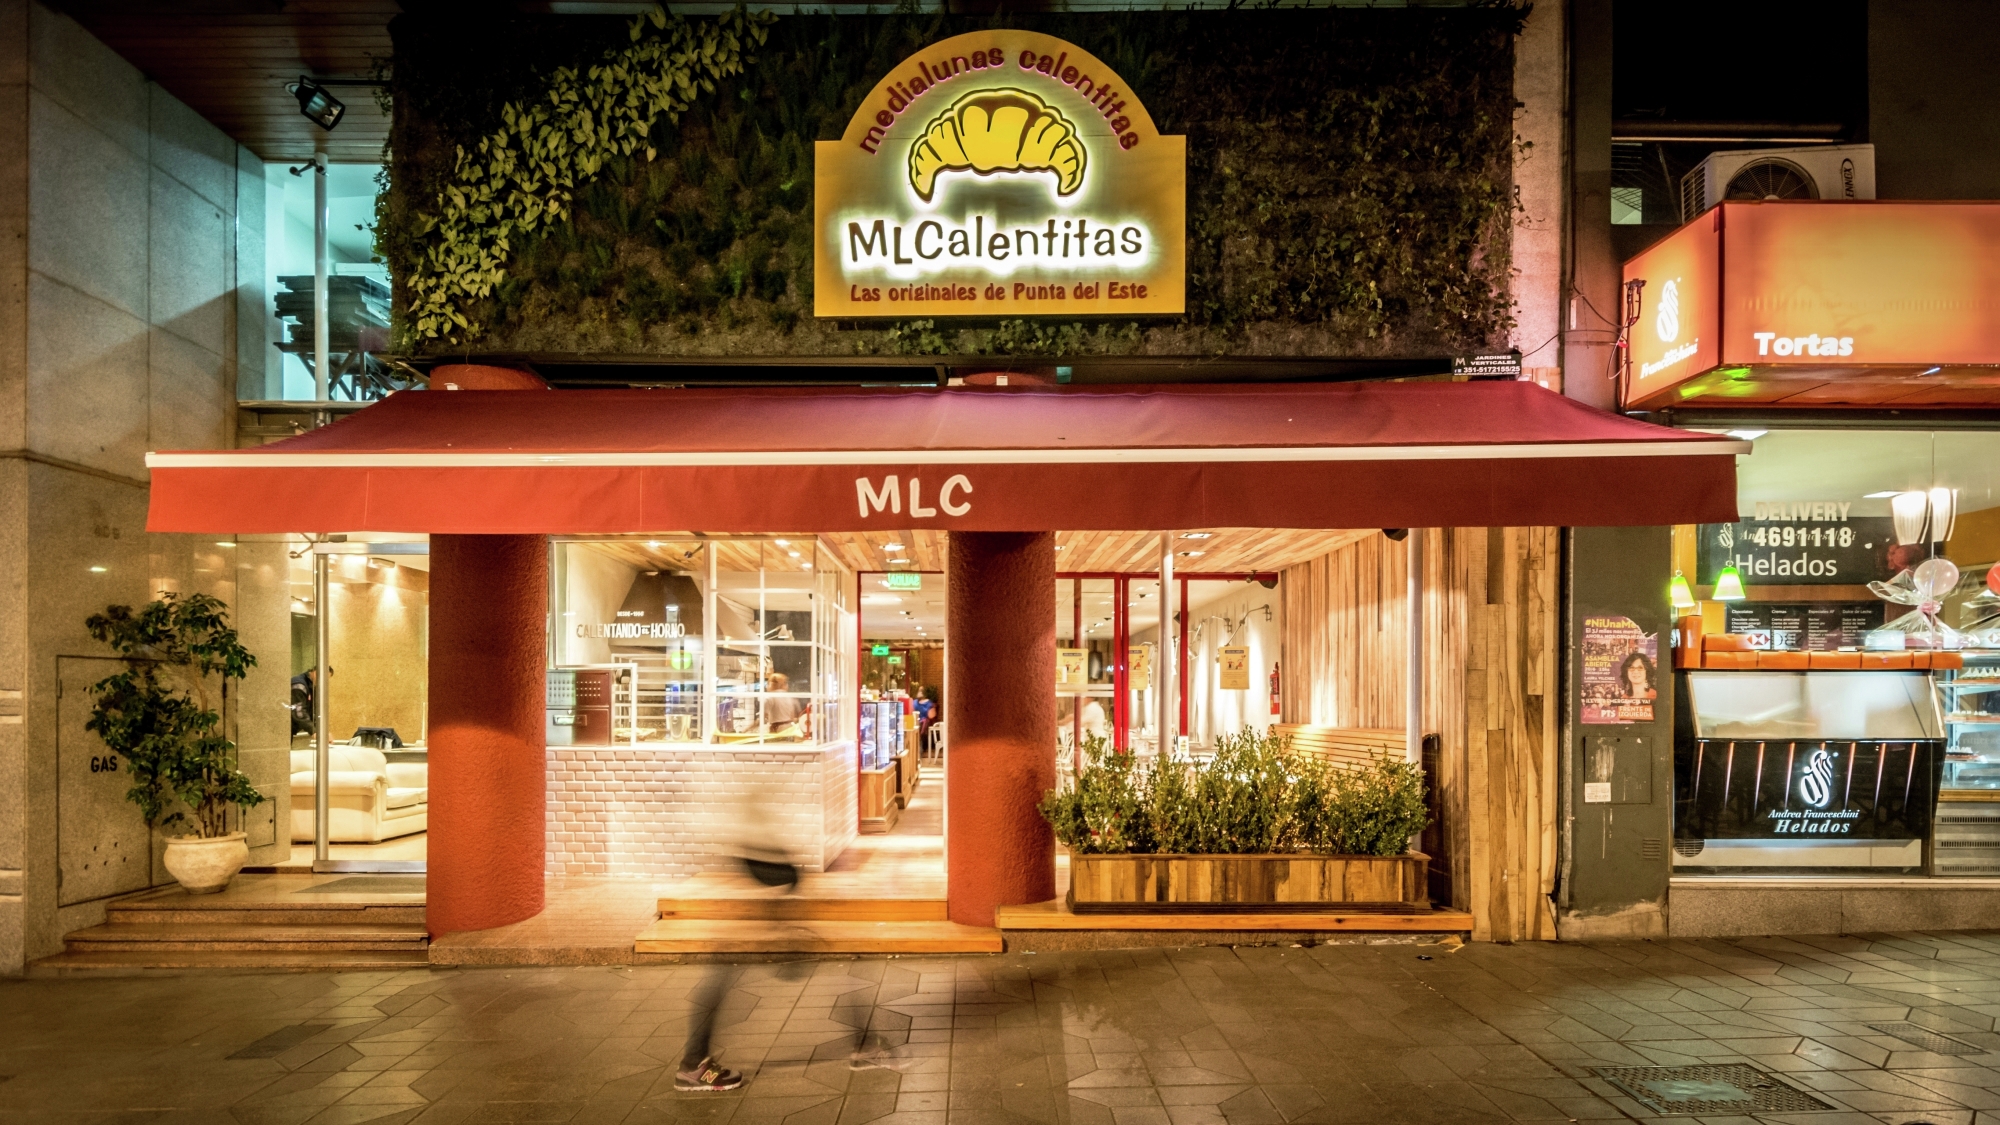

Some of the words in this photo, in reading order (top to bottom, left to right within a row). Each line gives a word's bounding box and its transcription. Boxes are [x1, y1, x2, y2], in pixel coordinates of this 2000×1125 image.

[859, 47, 1005, 155] medialunas
[1018, 48, 1140, 151] calentitas
[1843, 167, 1854, 199] ENNOX
[848, 215, 1143, 265] MLCalentitas
[851, 284, 881, 302] Las
[888, 283, 978, 302] originales
[984, 283, 1006, 301] de
[1013, 282, 1066, 301] Punta
[1073, 281, 1100, 300] del
[1108, 281, 1148, 300] Este
[1753, 332, 1854, 357] Tortas
[855, 474, 973, 518] MLC
[1755, 501, 1851, 522] DELIVERY
[1753, 526, 1853, 548] 4691118
[1735, 551, 1838, 577] Helados
[576, 623, 642, 639] CALENTANDO
[650, 623, 686, 639] HORNO
[1600, 709, 1617, 719] PTS
[90, 755, 118, 773] GAS
[1768, 808, 1801, 818] Andrea
[1803, 808, 1860, 818] Franceschini
[1773, 818, 1851, 834] Helados
